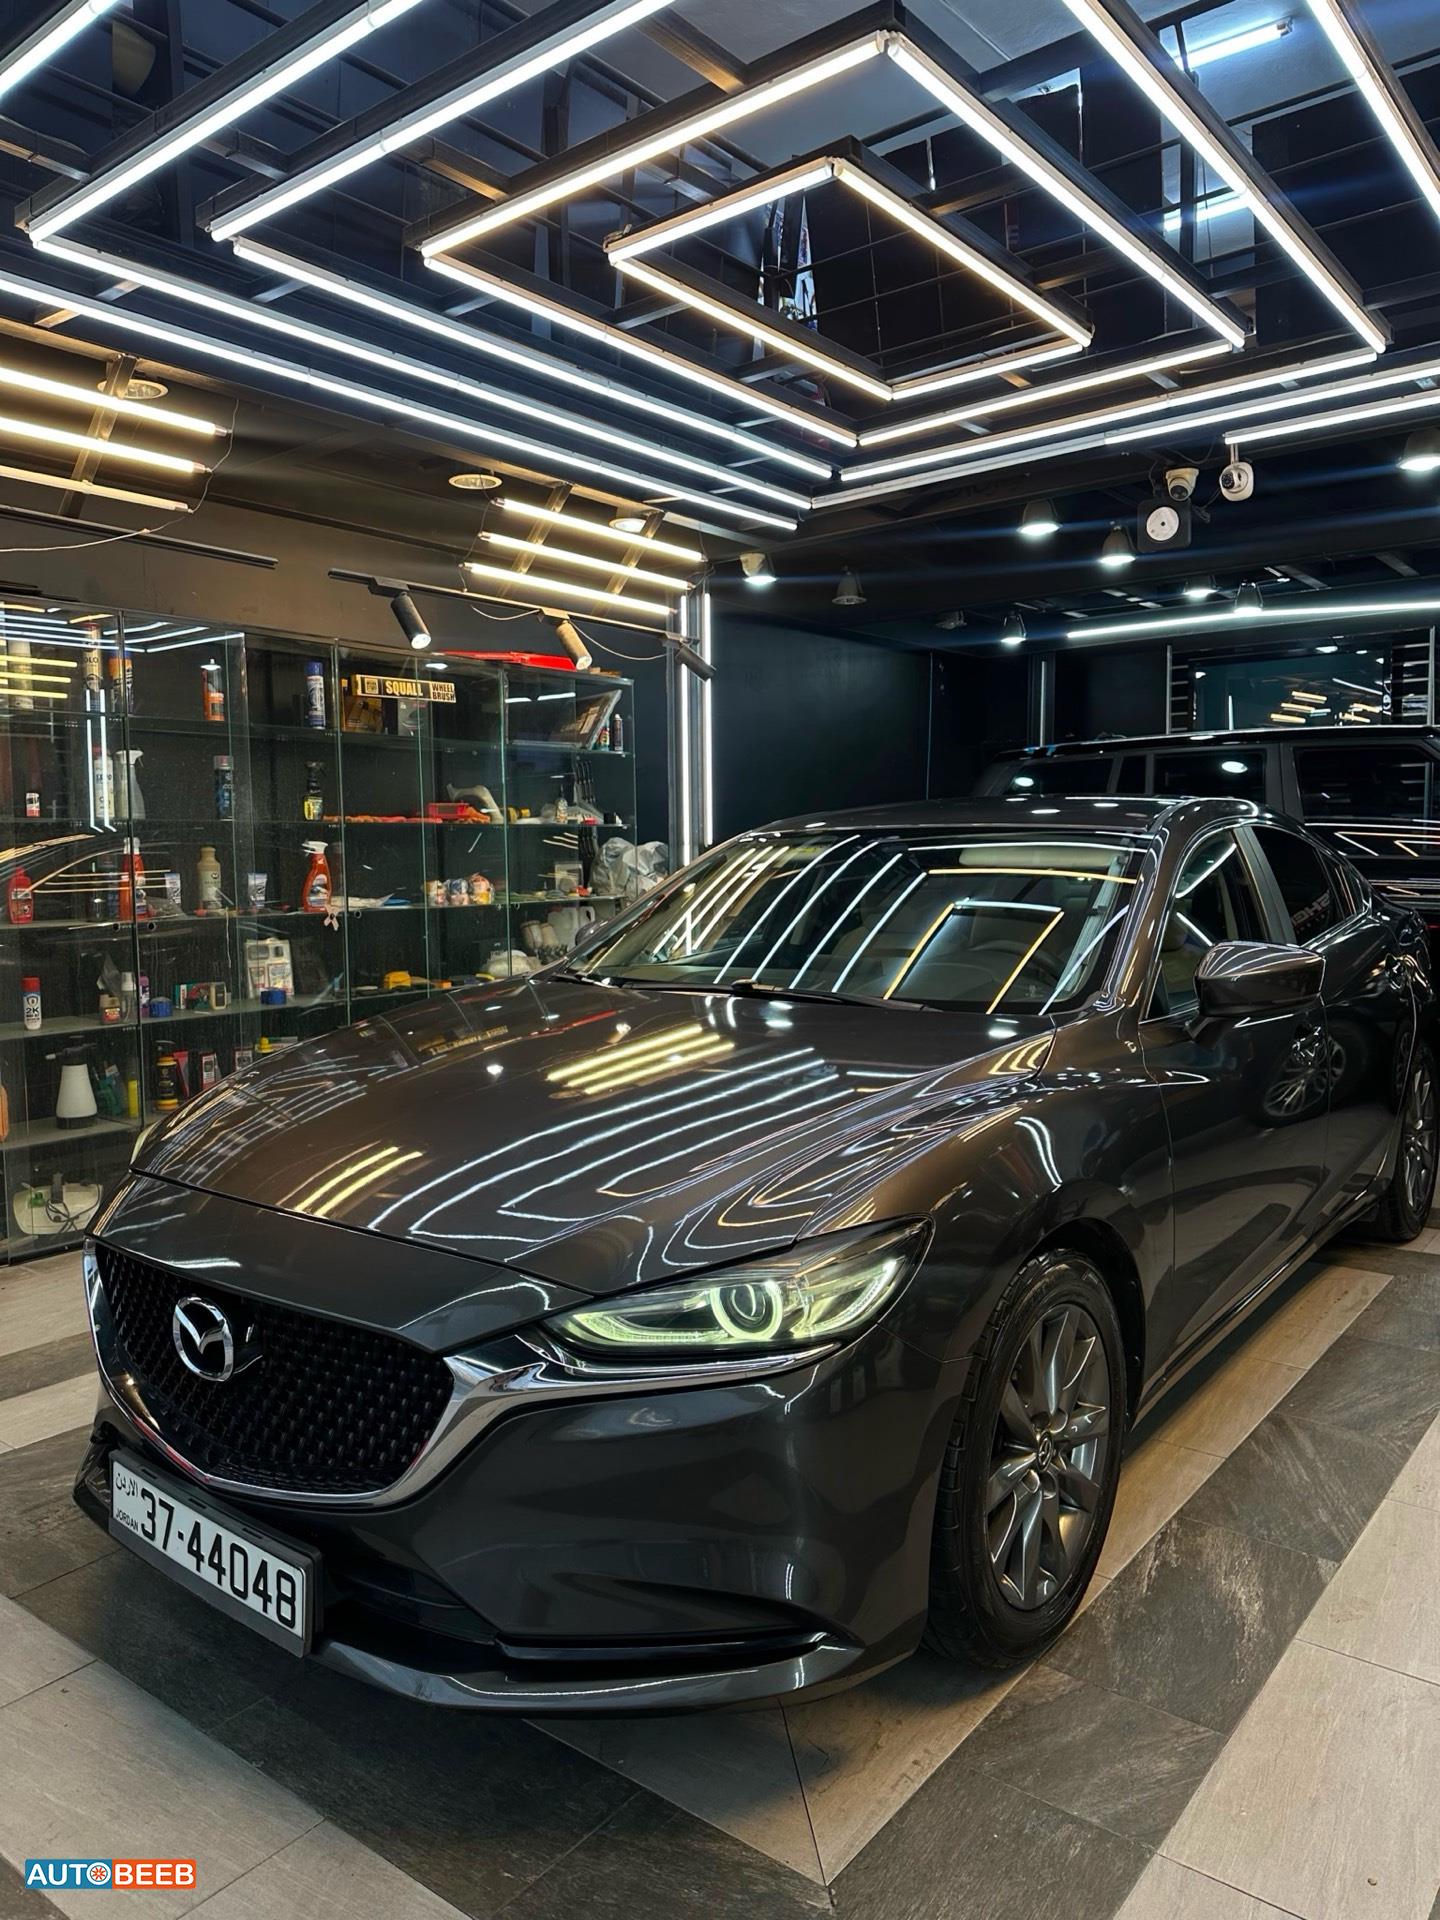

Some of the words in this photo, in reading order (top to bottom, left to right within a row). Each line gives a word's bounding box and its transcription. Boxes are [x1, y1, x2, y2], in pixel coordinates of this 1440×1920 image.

[385, 680, 424, 697] SQUALL
[432, 683, 454, 693] WHEEL
[432, 691, 455, 701] BRUSH
[115, 1508, 139, 1532] JORDAN
[140, 1488, 296, 1629] 37-44048
